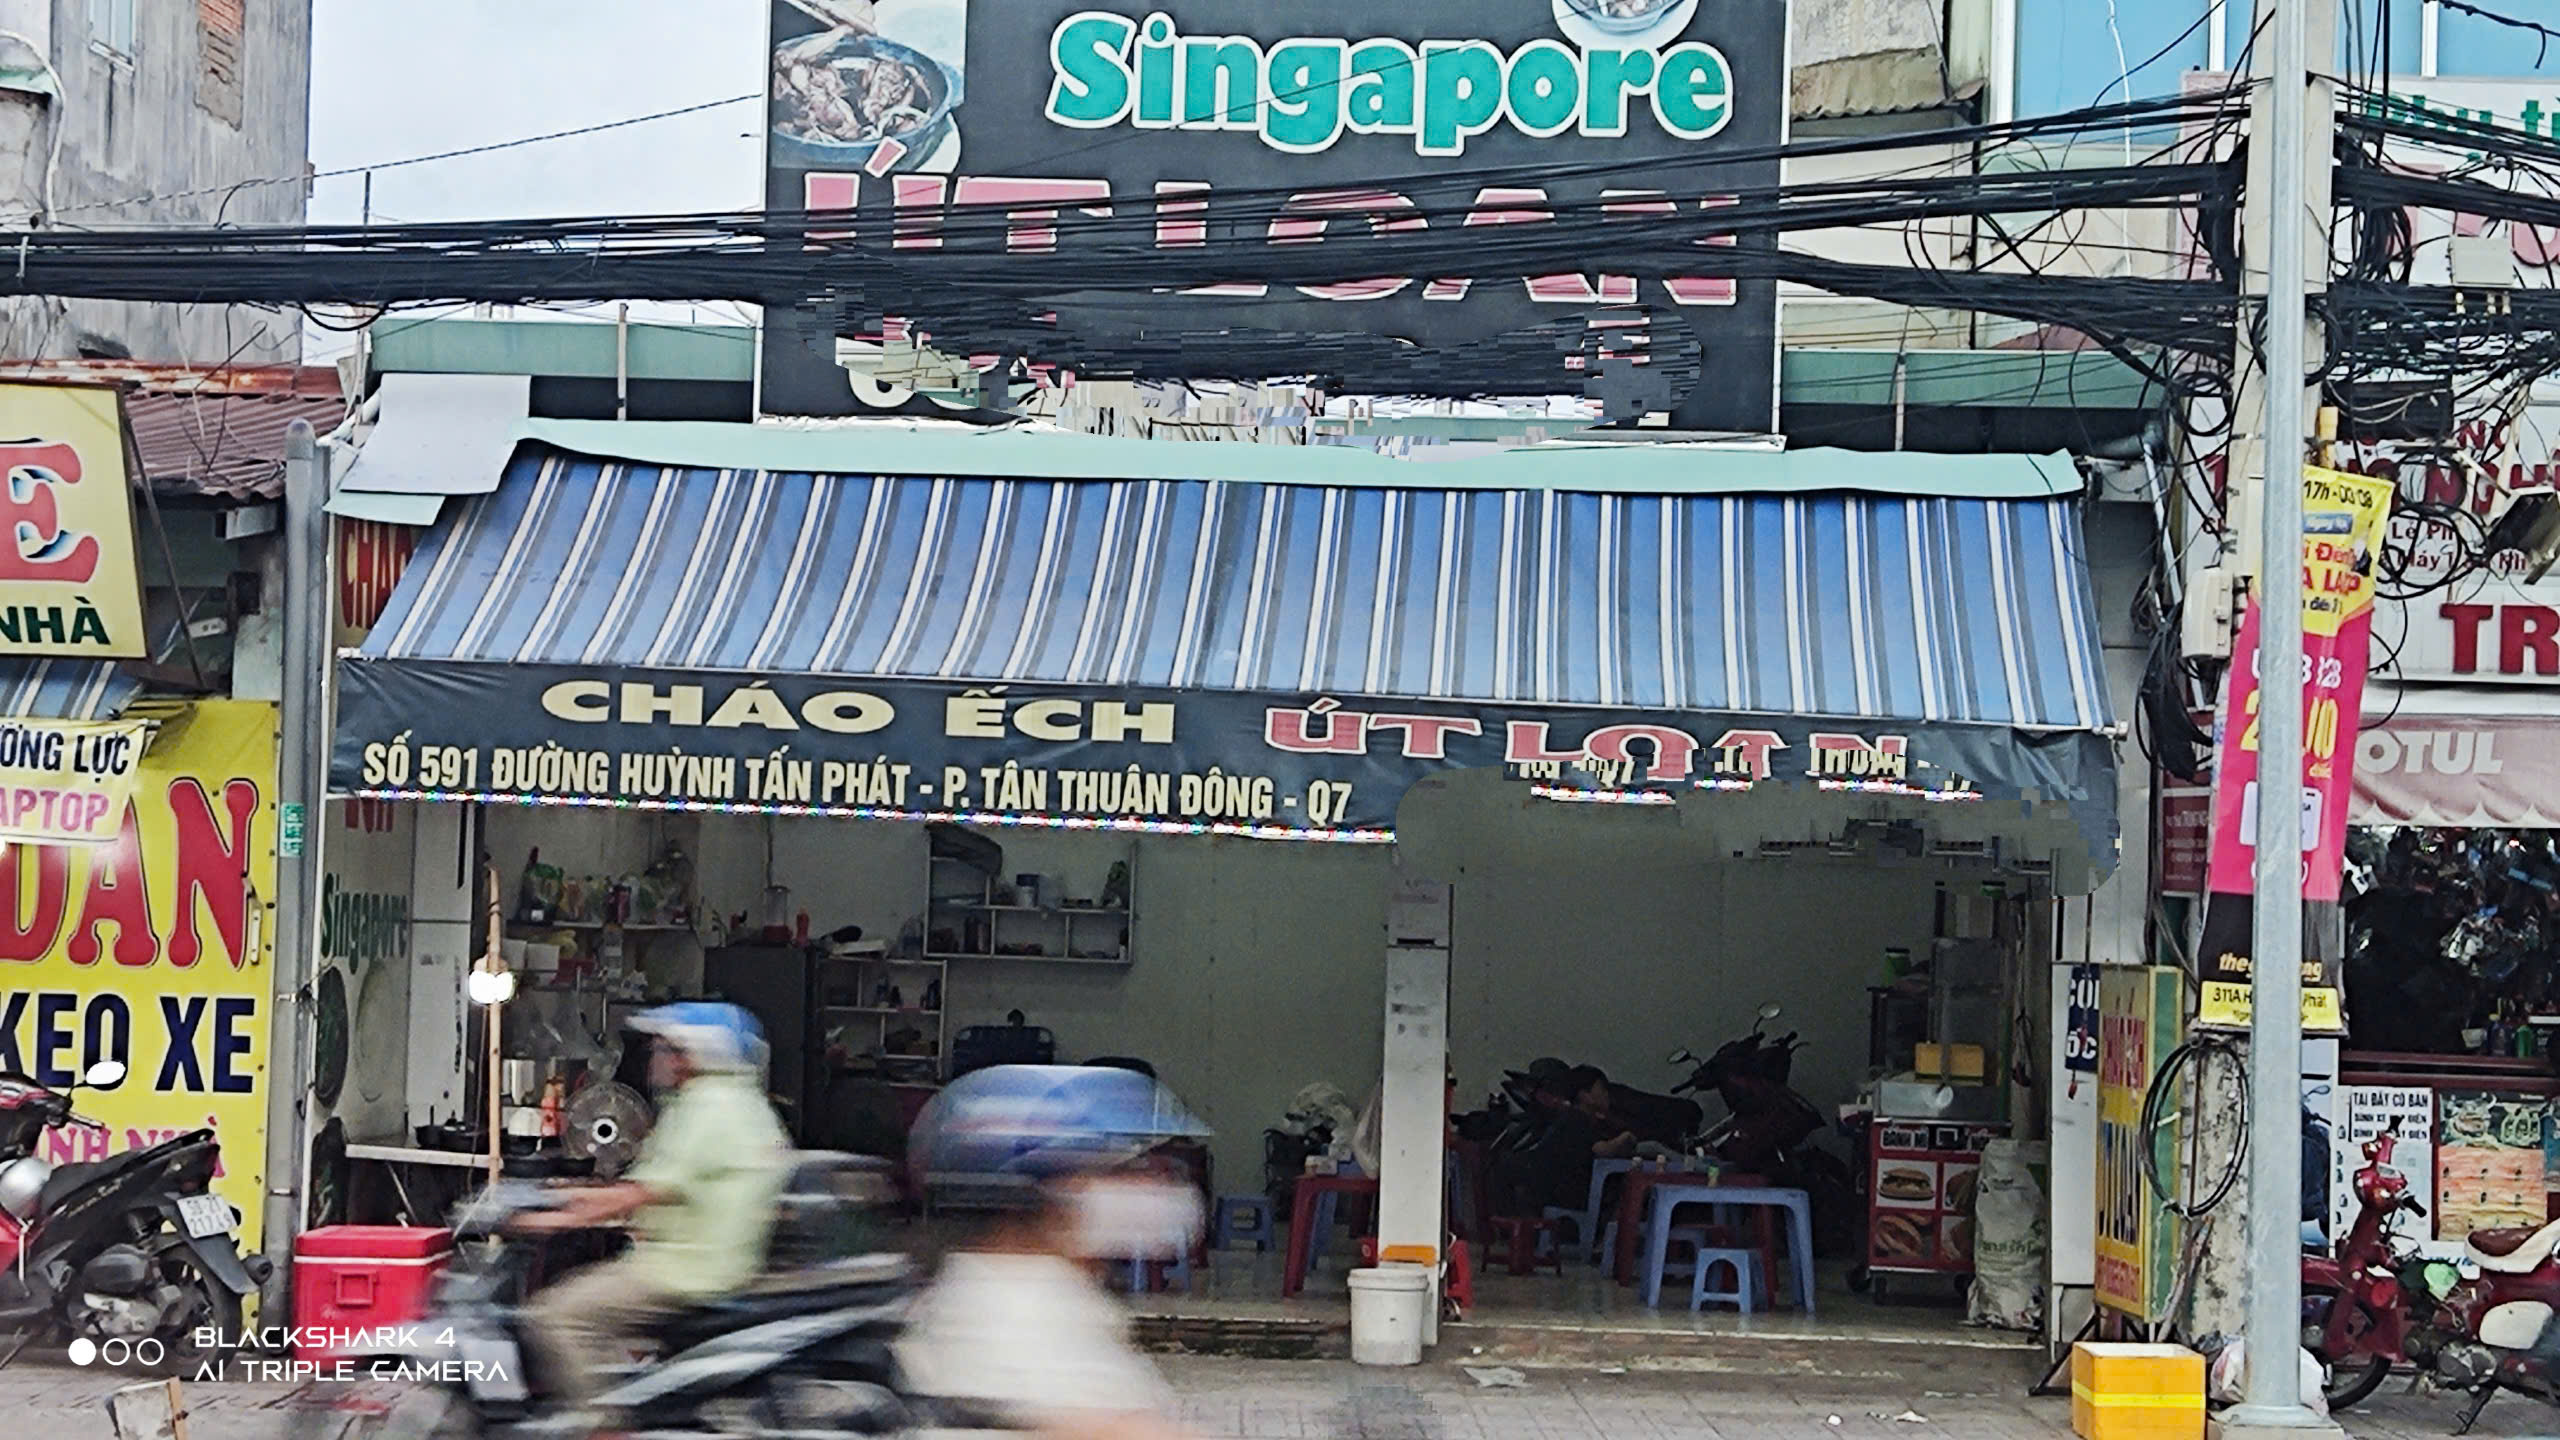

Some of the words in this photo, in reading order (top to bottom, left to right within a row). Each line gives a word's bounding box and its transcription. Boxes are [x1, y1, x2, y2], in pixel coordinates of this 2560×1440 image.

[1046, 8, 1732, 156] Singapore
[74, 731, 131, 783] LỰC
[541, 680, 896, 733] CHÁO
[945, 685, 1175, 744] ẾCH
[1265, 697, 1483, 759] ÚT
[363, 729, 413, 786] SỐ
[418, 745, 478, 789] 591
[491, 739, 610, 792] ĐƯỜNG
[619, 746, 736, 799] HUỲNH
[745, 745, 812, 801] TẤN
[821, 754, 912, 805] PHÁT
[943, 766, 970, 808] P.
[980, 759, 1048, 811] TÂN
[1179, 766, 1274, 819] ĐÔNG
[1308, 779, 1353, 828] Q7
[155, 996, 256, 1094] XE
[33, 1126, 112, 1166] NH
